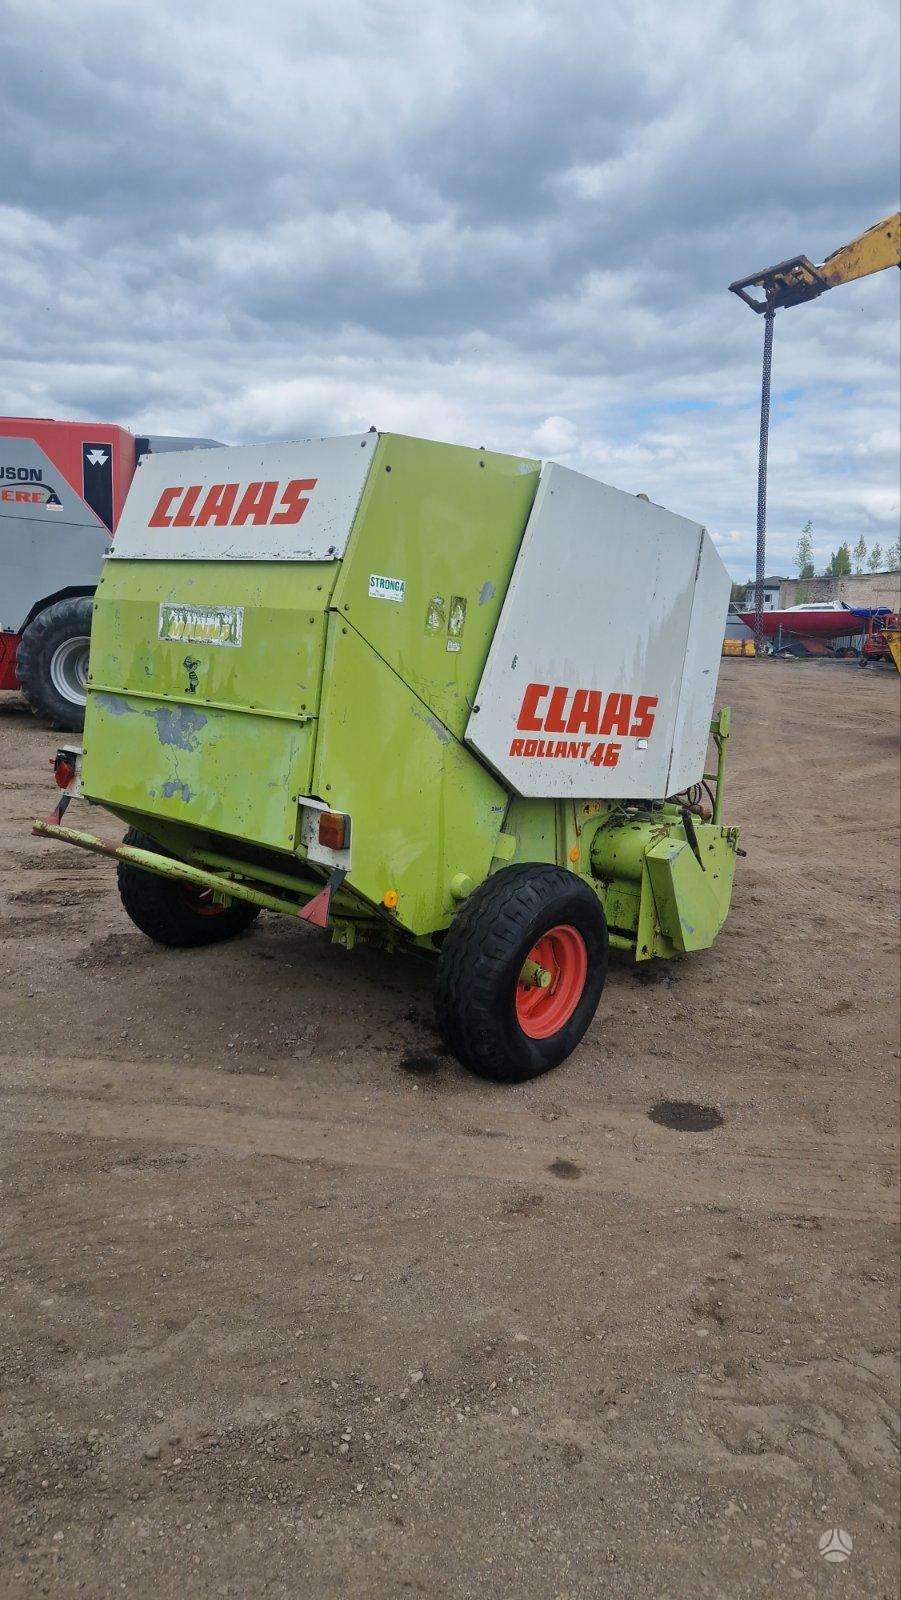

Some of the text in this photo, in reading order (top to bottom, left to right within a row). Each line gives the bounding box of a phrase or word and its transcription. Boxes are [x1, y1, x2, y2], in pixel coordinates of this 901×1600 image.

[148, 478, 318, 527] CLAAS
[370, 576, 405, 593] STRONGA
[516, 683, 659, 738] CLAAS
[509, 738, 622, 767] ROLLANT 46
